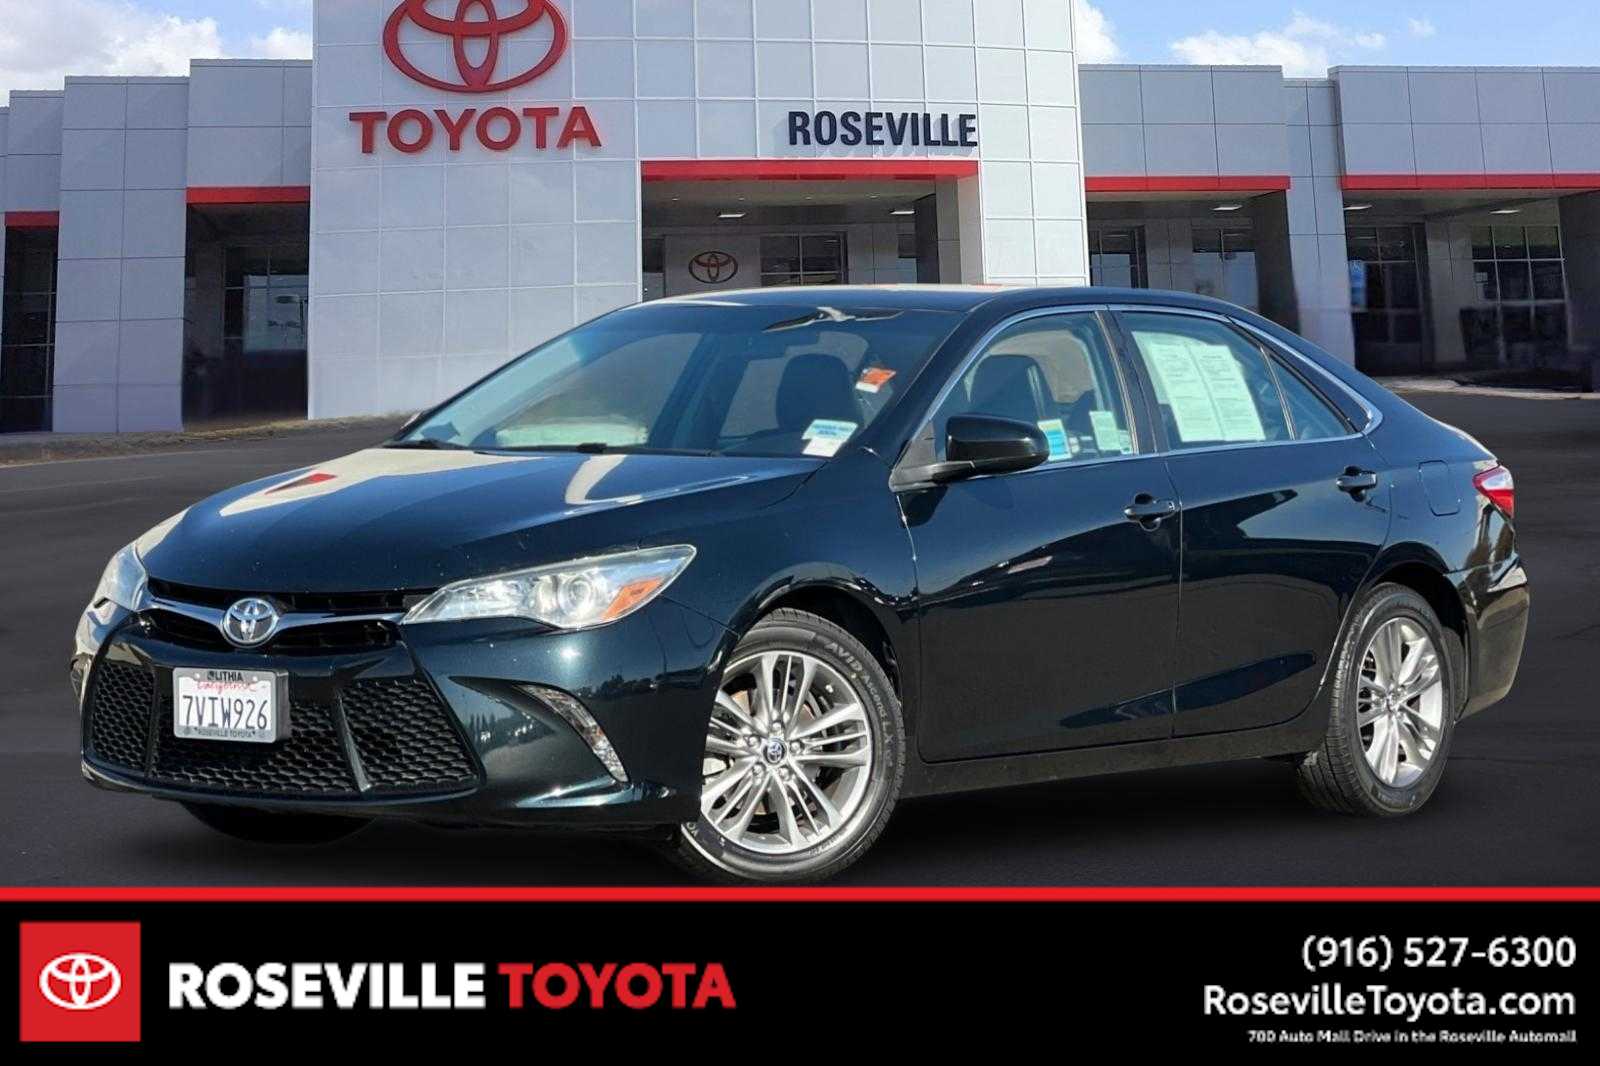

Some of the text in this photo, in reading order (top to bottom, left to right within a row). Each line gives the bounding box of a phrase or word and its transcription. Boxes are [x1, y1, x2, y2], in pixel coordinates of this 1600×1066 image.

[349, 106, 602, 154] TOYOTA
[788, 110, 979, 148] ROSEVILLE
[214, 671, 243, 682] LITHIA
[182, 694, 268, 730] 7VIW926
